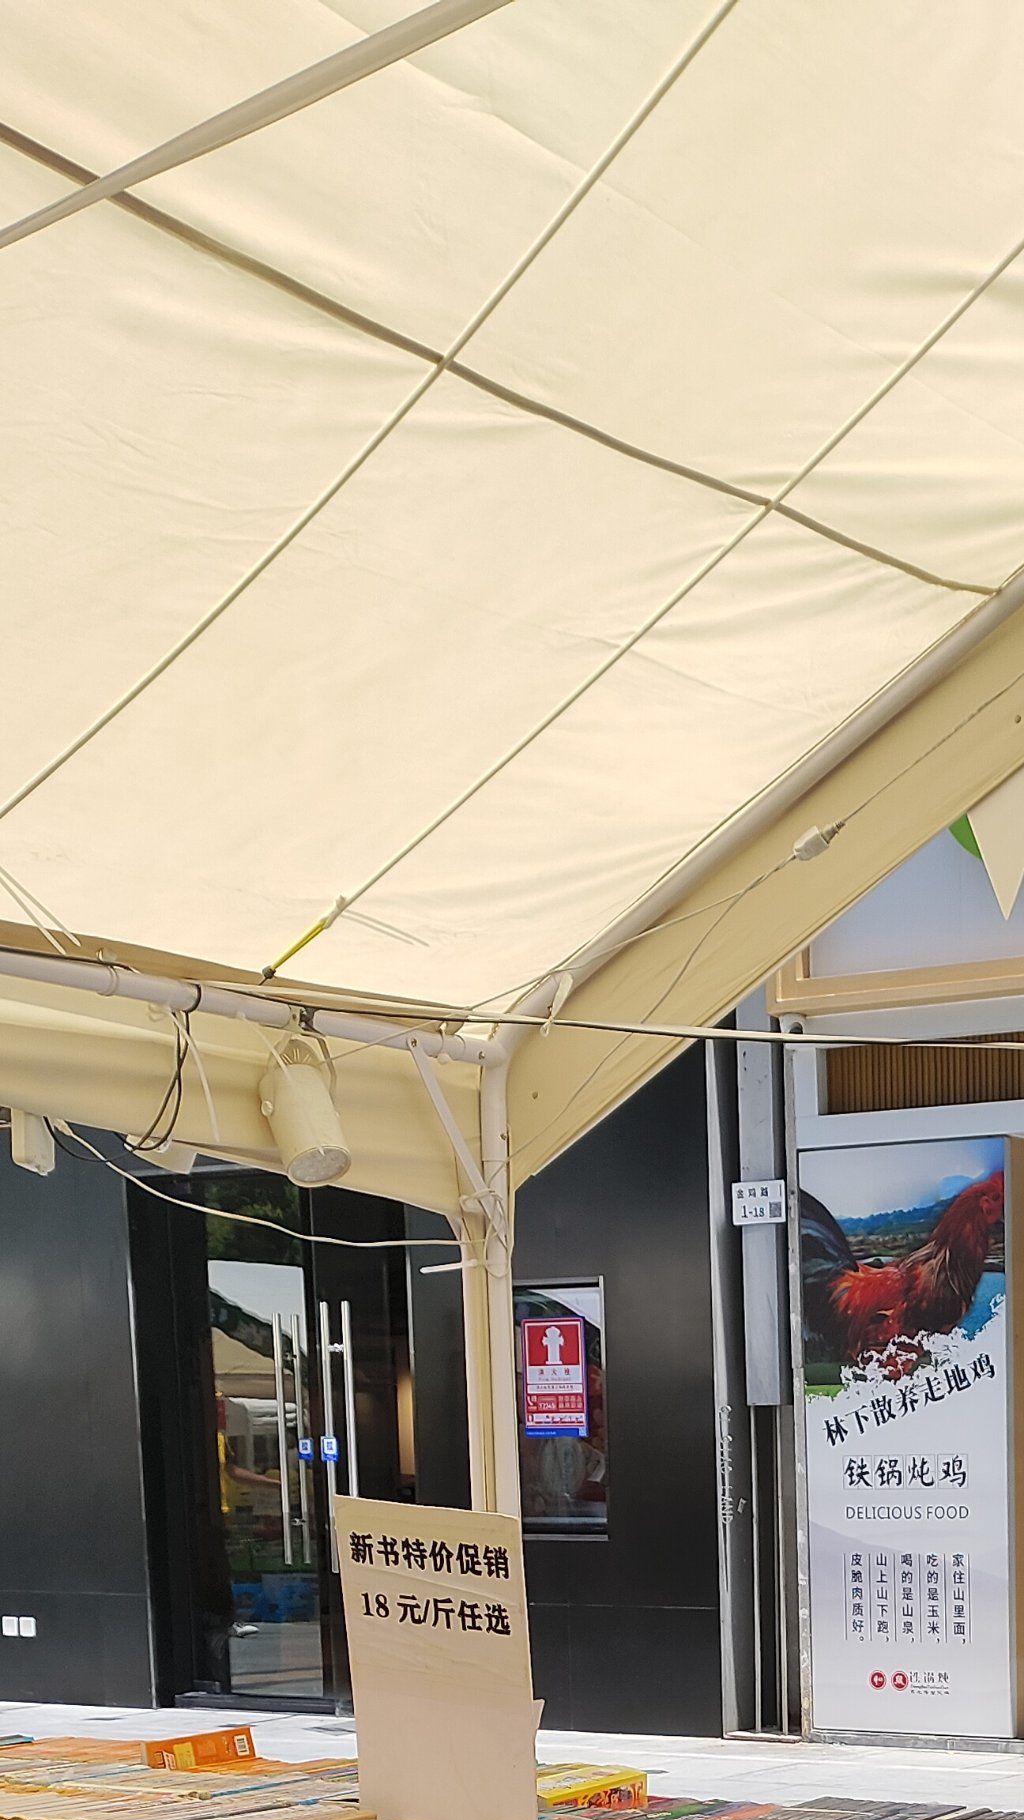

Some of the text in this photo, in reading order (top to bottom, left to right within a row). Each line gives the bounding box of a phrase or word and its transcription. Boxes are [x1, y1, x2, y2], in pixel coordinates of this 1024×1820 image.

[822, 1353, 997, 1447] 林下散养走地鸡
[844, 1454, 968, 1489] 铁锅炖鸡
[845, 1505, 969, 1520] DELICIOUS FOOD
[349, 1531, 510, 1580] 新书特价促销
[361, 1592, 512, 1636] 18 元/斤任选
